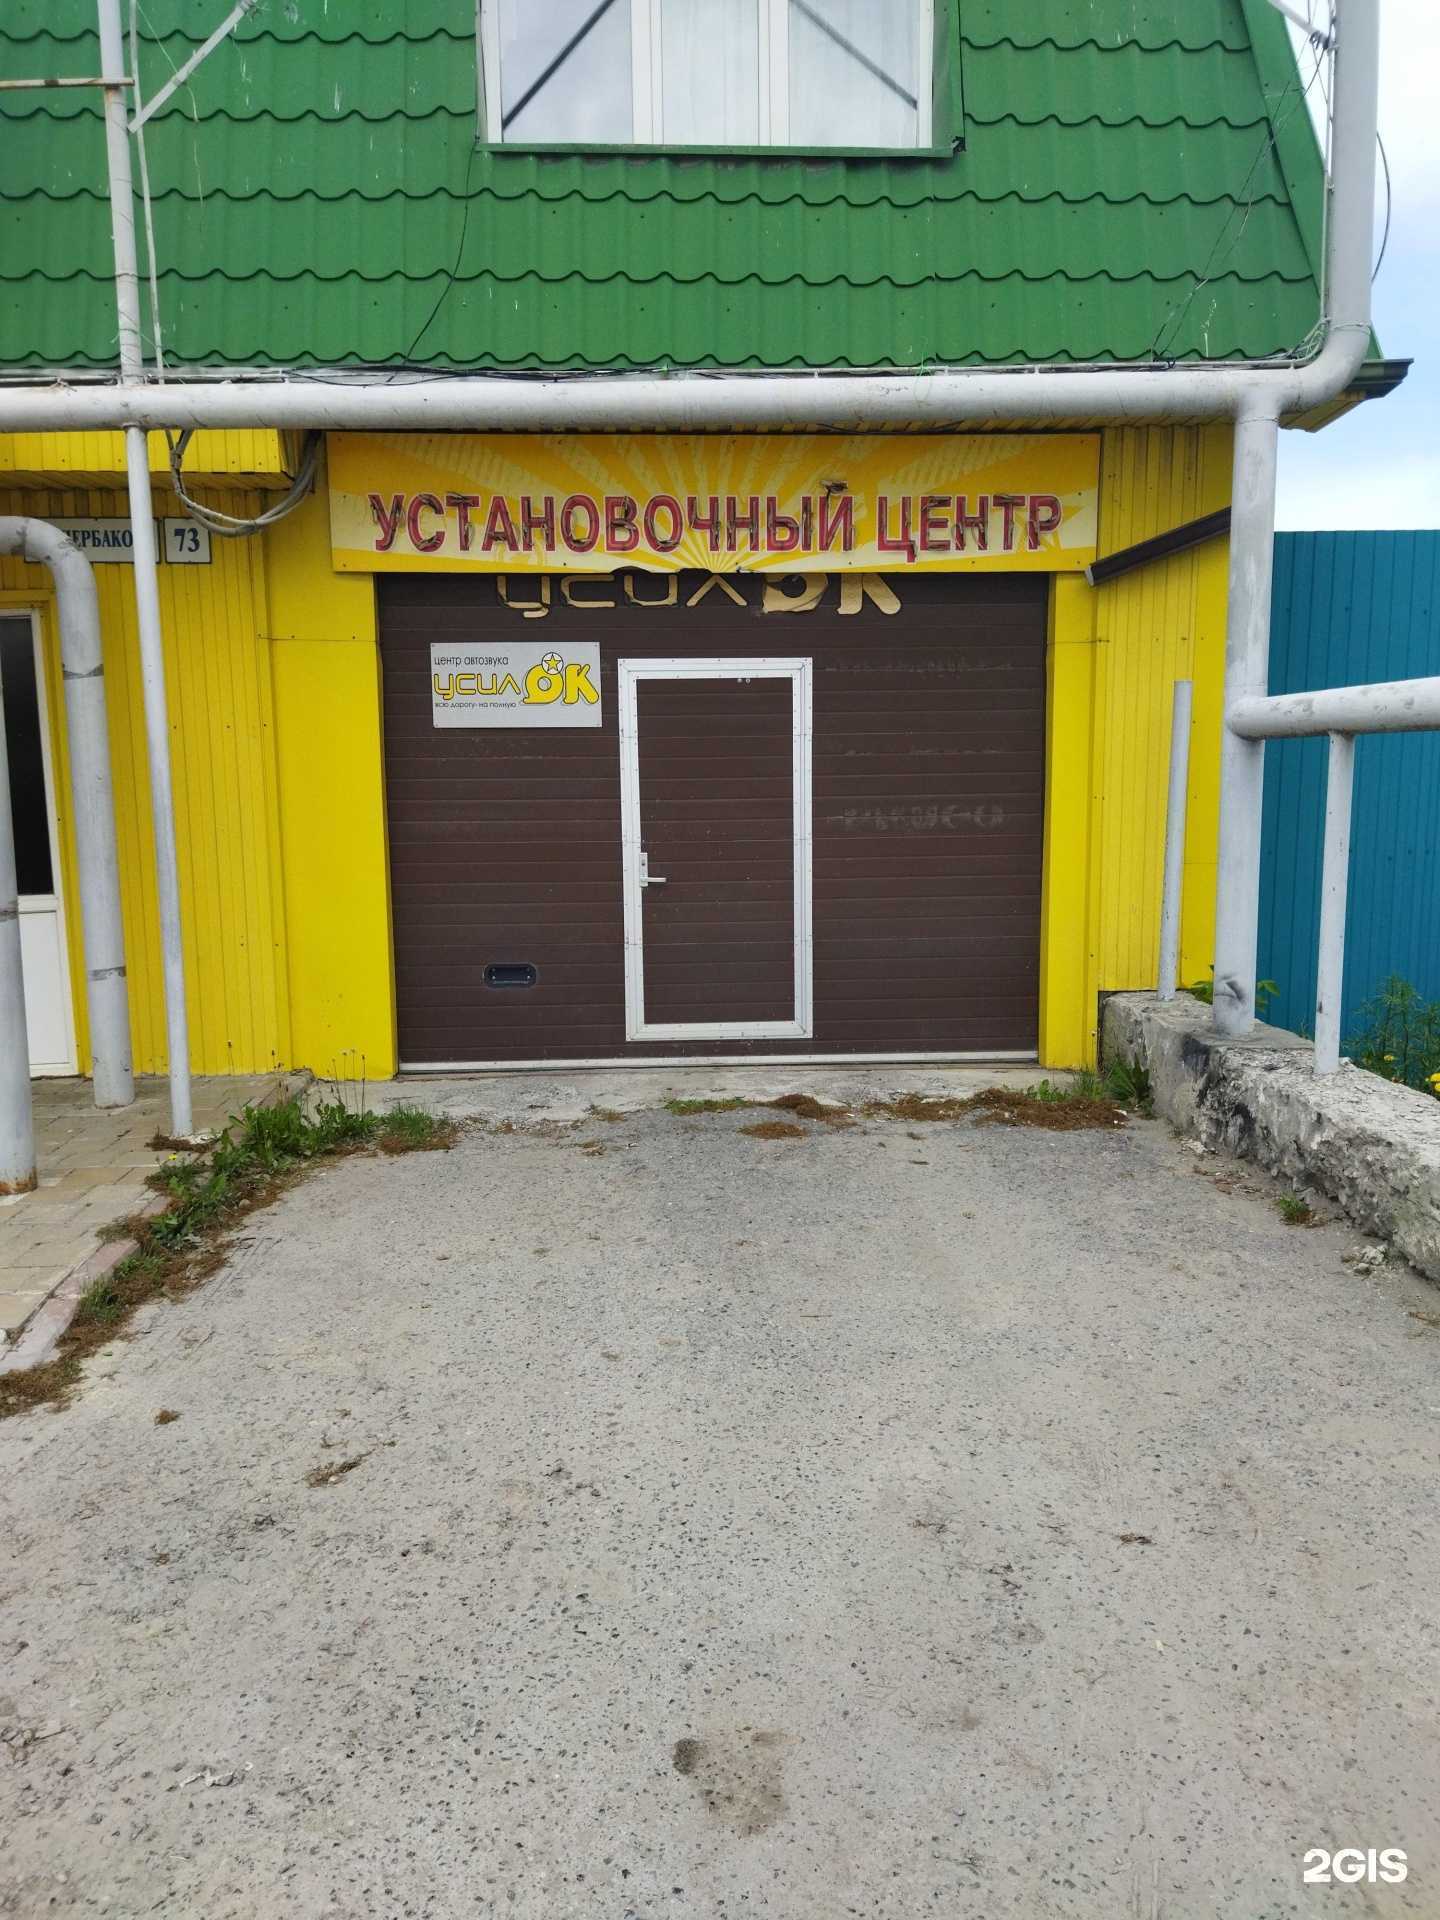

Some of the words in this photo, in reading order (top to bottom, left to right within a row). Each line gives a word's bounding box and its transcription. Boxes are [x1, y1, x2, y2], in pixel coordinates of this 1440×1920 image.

[368, 482, 855, 553] УСТАНОВОЧНЫЙ
[876, 493, 1063, 563] ЦЕНТР
[64, 529, 133, 548] ЕРБАКО
[174, 528, 200, 552] 73
[434, 656, 462, 667] центр
[464, 656, 509, 667] автозвука
